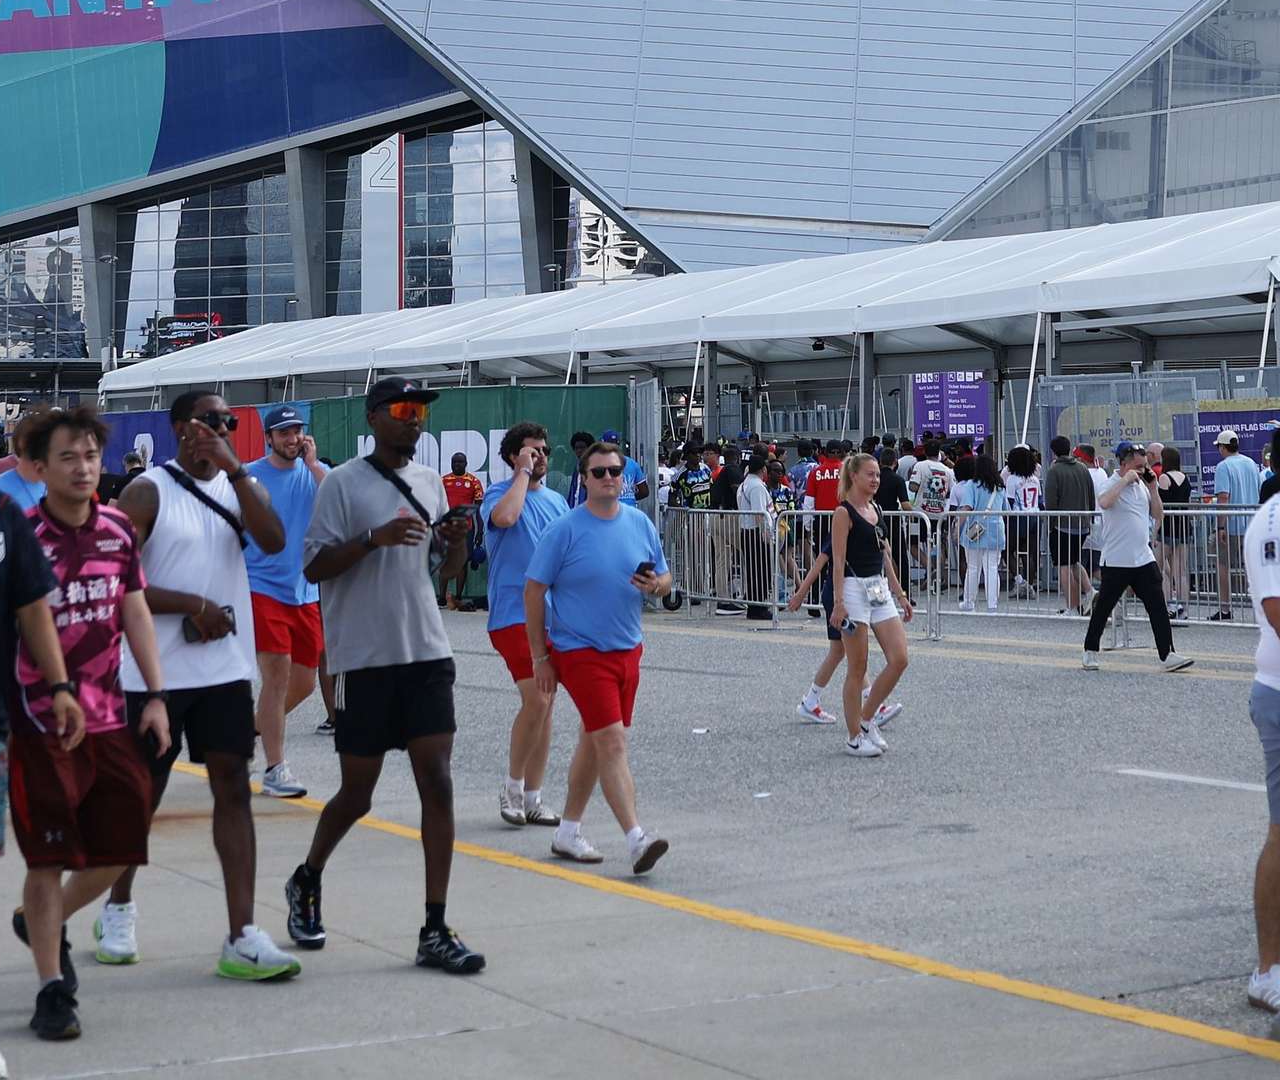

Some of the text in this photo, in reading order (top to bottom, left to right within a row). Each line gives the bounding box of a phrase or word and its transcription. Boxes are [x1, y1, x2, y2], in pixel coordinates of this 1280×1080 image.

[1125, 427, 1143, 436] CUP
[1198, 425, 1221, 433] CHECK
[1222, 424, 1240, 432] YOUR
[1240, 423, 1258, 431] FLAG
[1023, 487, 1037, 508] 17
